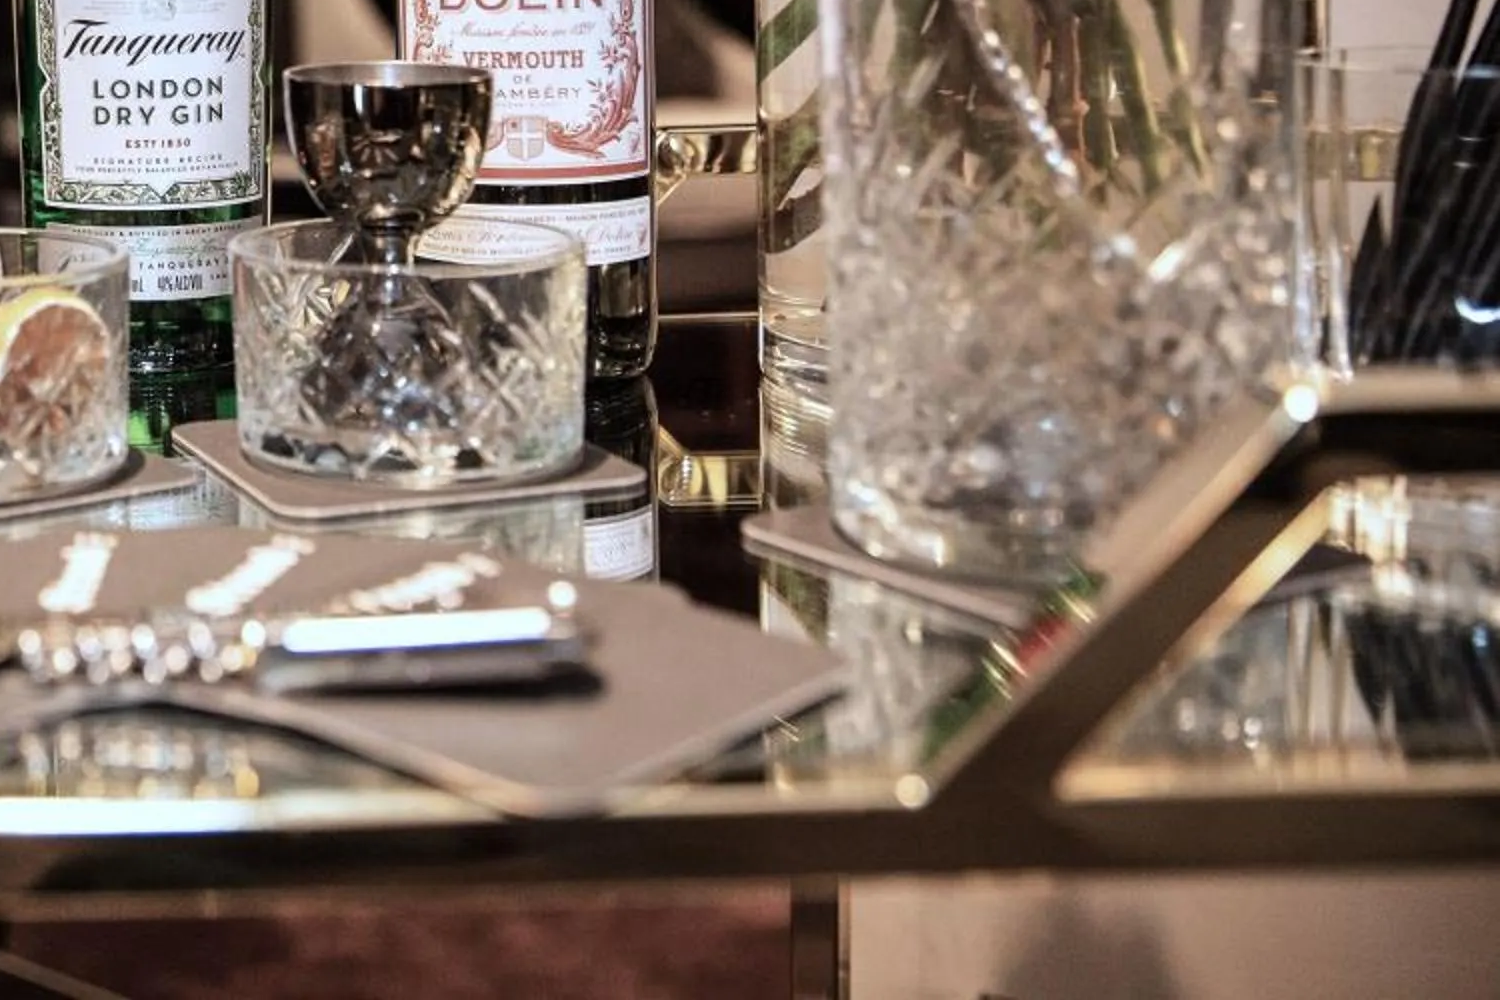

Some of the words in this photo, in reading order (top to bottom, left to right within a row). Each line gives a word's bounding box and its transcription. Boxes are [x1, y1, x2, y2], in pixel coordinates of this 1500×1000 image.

[64, 19, 246, 67] Tanqueray
[463, 49, 585, 69] VERMOUTH
[92, 75, 224, 100] LONDON
[496, 84, 581, 100] AMBÉRY
[93, 106, 156, 126] DRY
[171, 103, 224, 125] GIN
[139, 256, 220, 270] TANQUERAY
